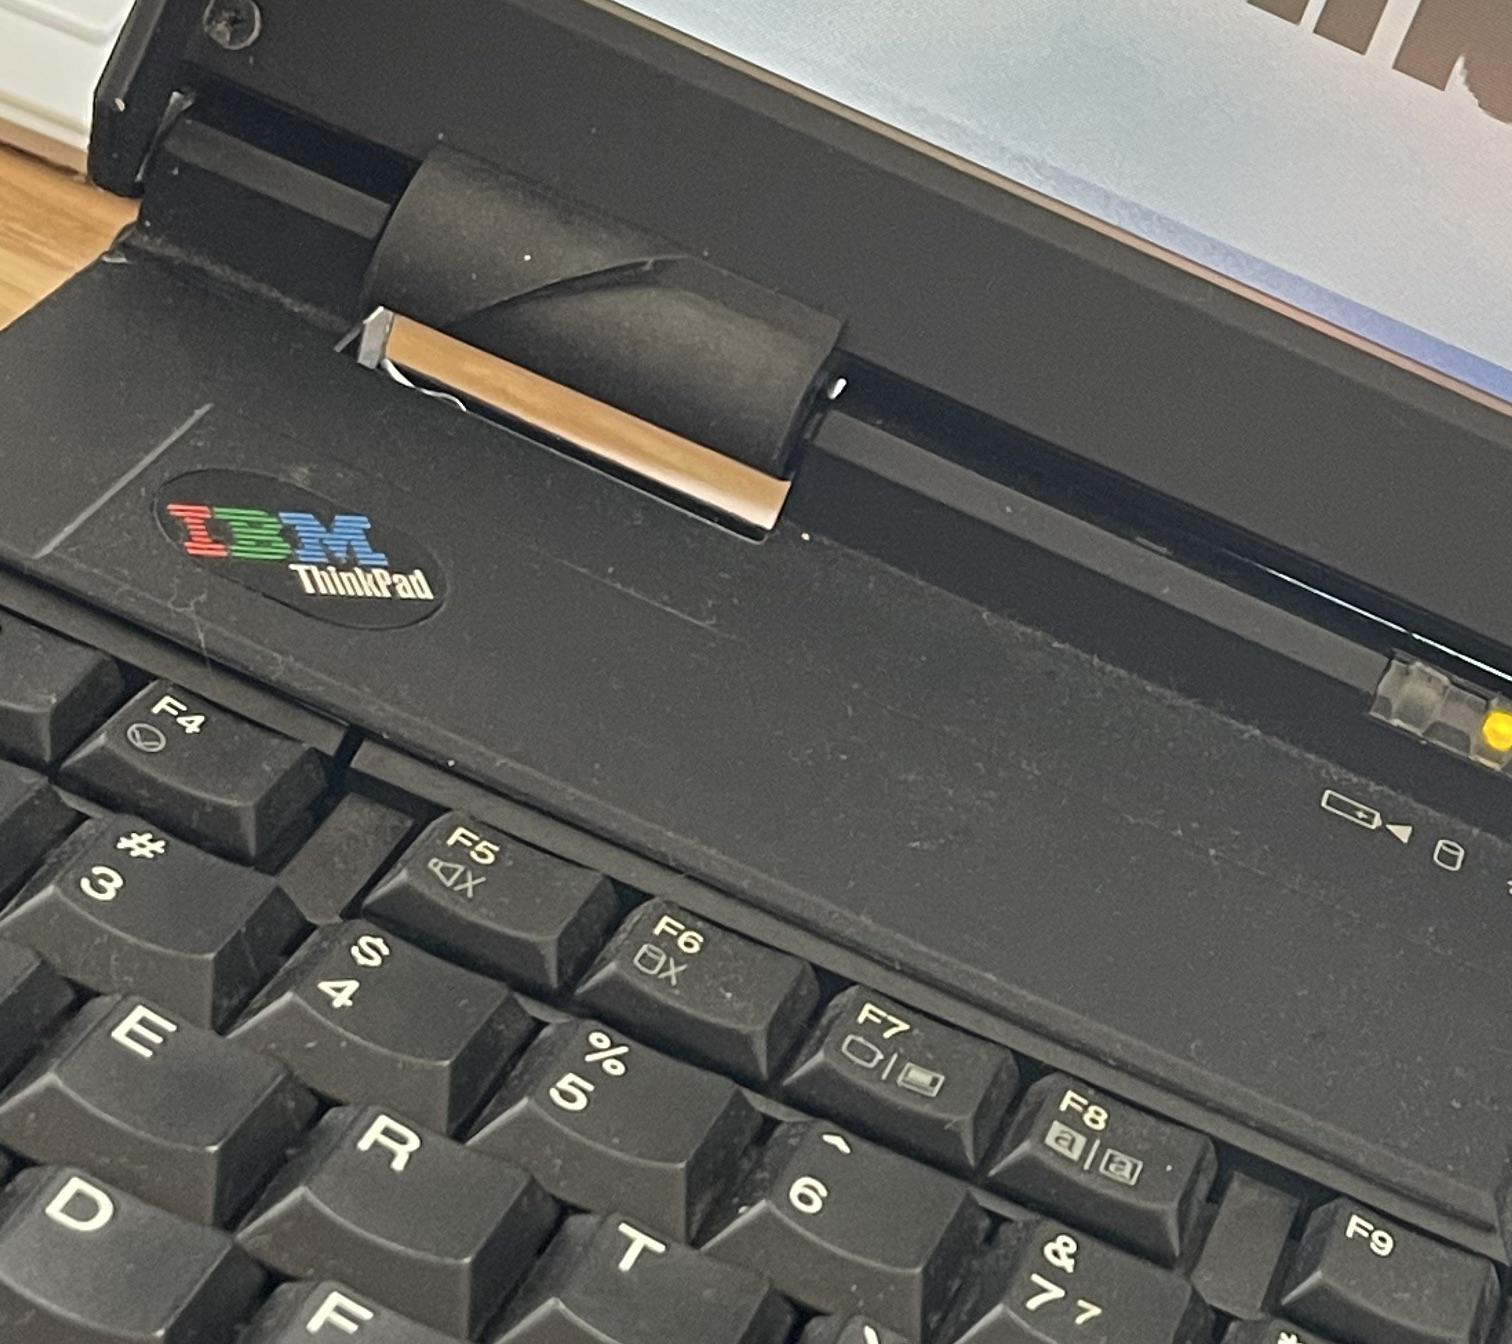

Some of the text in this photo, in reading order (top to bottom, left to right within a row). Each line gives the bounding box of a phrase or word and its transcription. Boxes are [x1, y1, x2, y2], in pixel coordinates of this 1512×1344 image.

[167, 504, 389, 567] IBM
[289, 563, 434, 601] ThinkPad
[152, 695, 206, 734] F4
[116, 832, 166, 859] #
[446, 827, 500, 865] F5
[80, 866, 124, 901] 3
[350, 935, 390, 967] $
[653, 915, 704, 955] F6
[317, 979, 360, 1008] 4
[111, 1004, 177, 1058] E
[857, 1003, 911, 1039] F7
[584, 1032, 629, 1076] %
[549, 1072, 595, 1111] 5
[1059, 1090, 1109, 1131] F8
[357, 1114, 421, 1172] R
[45, 1176, 114, 1232] D
[789, 1176, 828, 1214] 6
[618, 1222, 666, 1272] T
[1043, 1234, 1077, 1273] &
[1345, 1214, 1394, 1256] F9
[306, 1291, 374, 1334] F
[1025, 1273, 1102, 1325] 7 7
